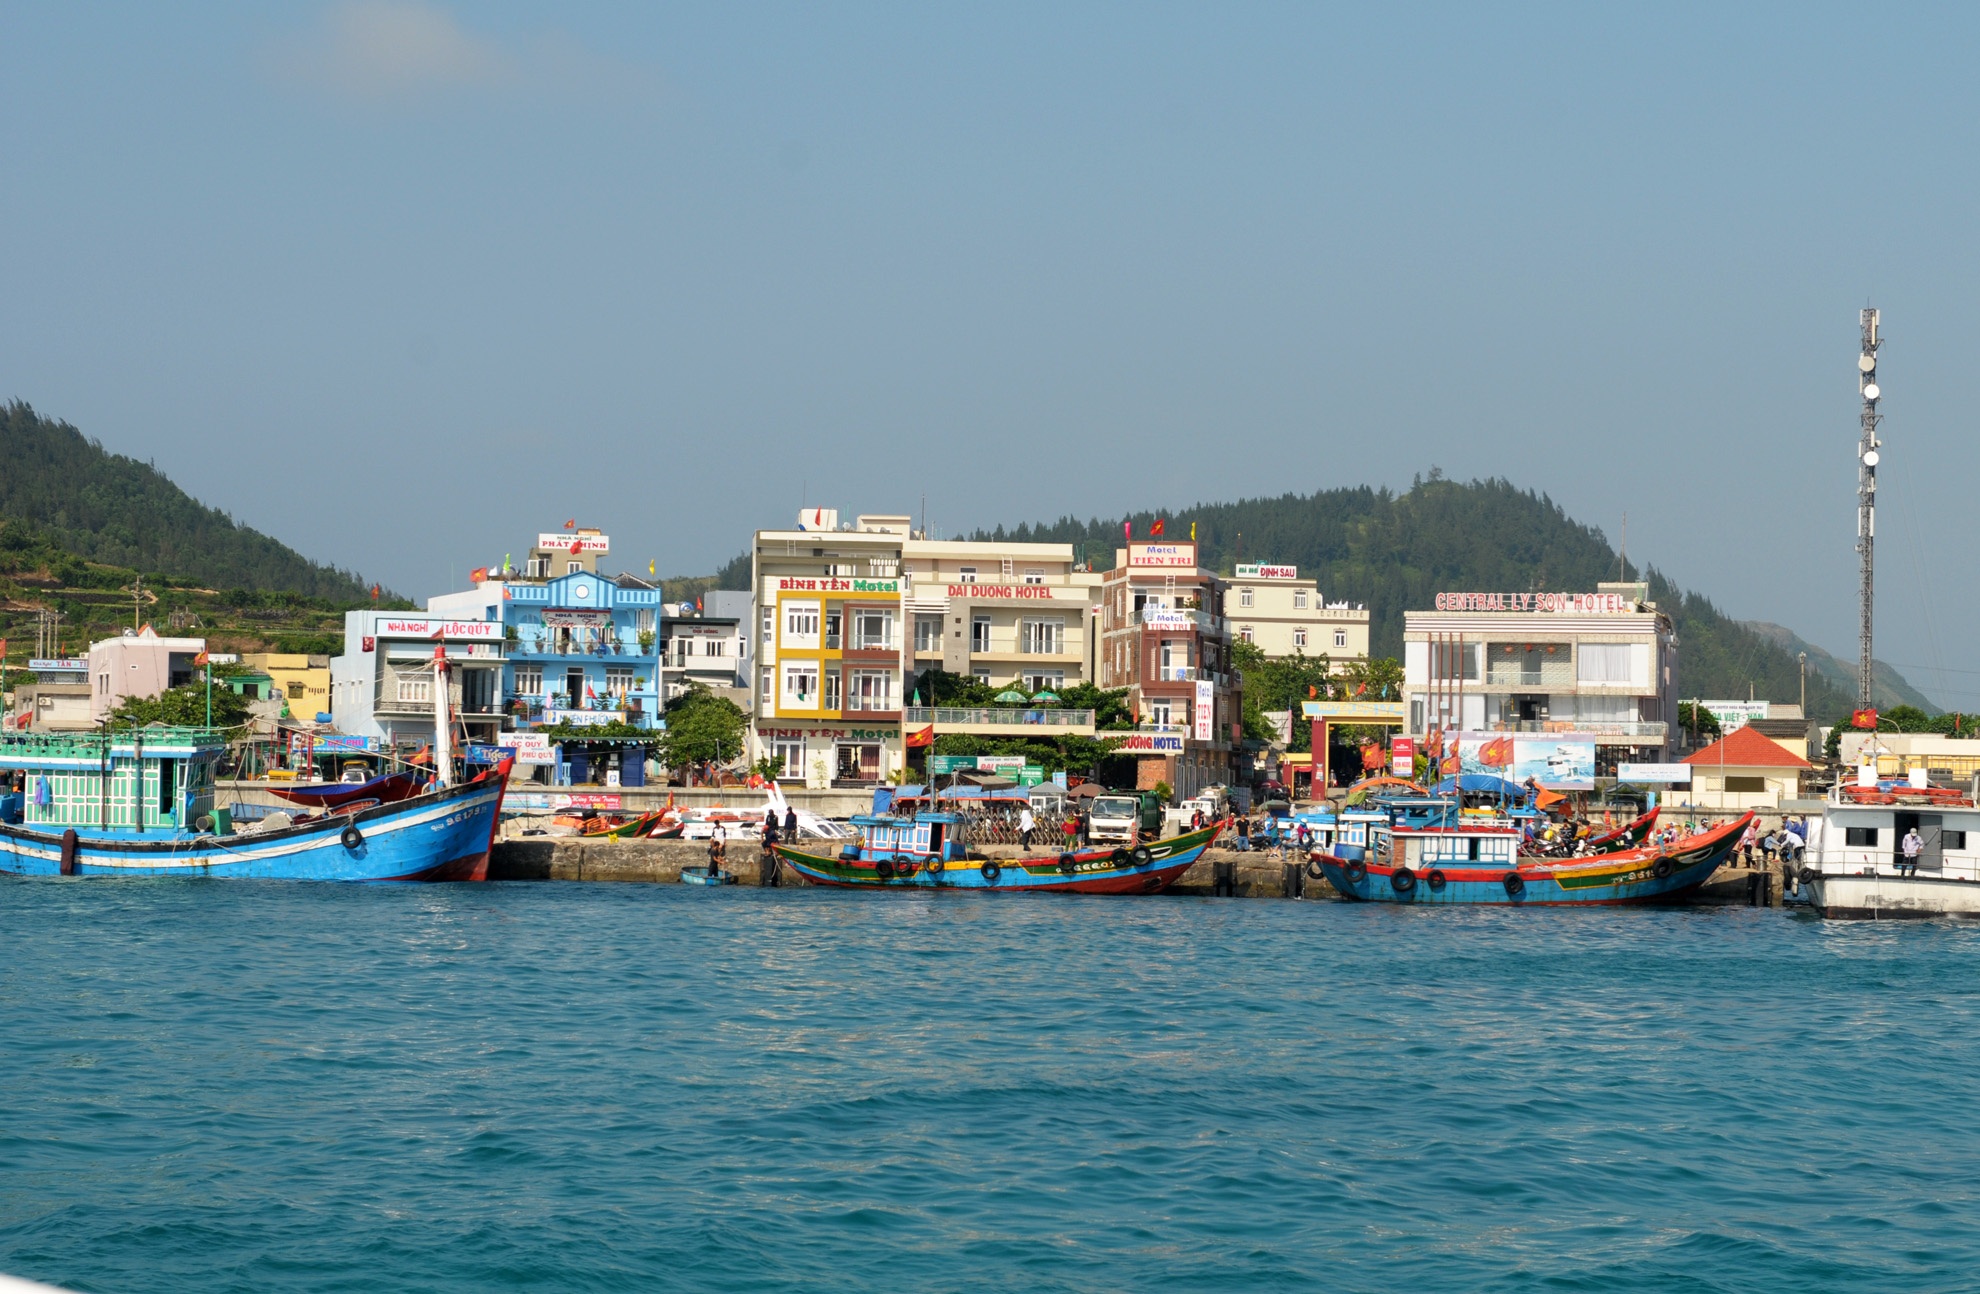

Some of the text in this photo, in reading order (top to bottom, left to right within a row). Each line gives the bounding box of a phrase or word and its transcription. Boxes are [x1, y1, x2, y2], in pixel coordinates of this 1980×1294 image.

[1279, 568, 1295, 577] SAU
[779, 576, 898, 591] BÌNH YÊN Motel
[948, 584, 1053, 599] DAI DUONG HOTEL
[1435, 592, 1624, 611] CENTRAL LY SON HOTEL
[388, 620, 406, 632] NHÀ
[407, 619, 429, 632] NGHỈ
[445, 621, 466, 636] LỘC
[757, 728, 803, 737] BÌNH
[851, 729, 899, 739] Motel
[1154, 737, 1183, 749] HOTEL
[481, 748, 509, 762] Tiger
